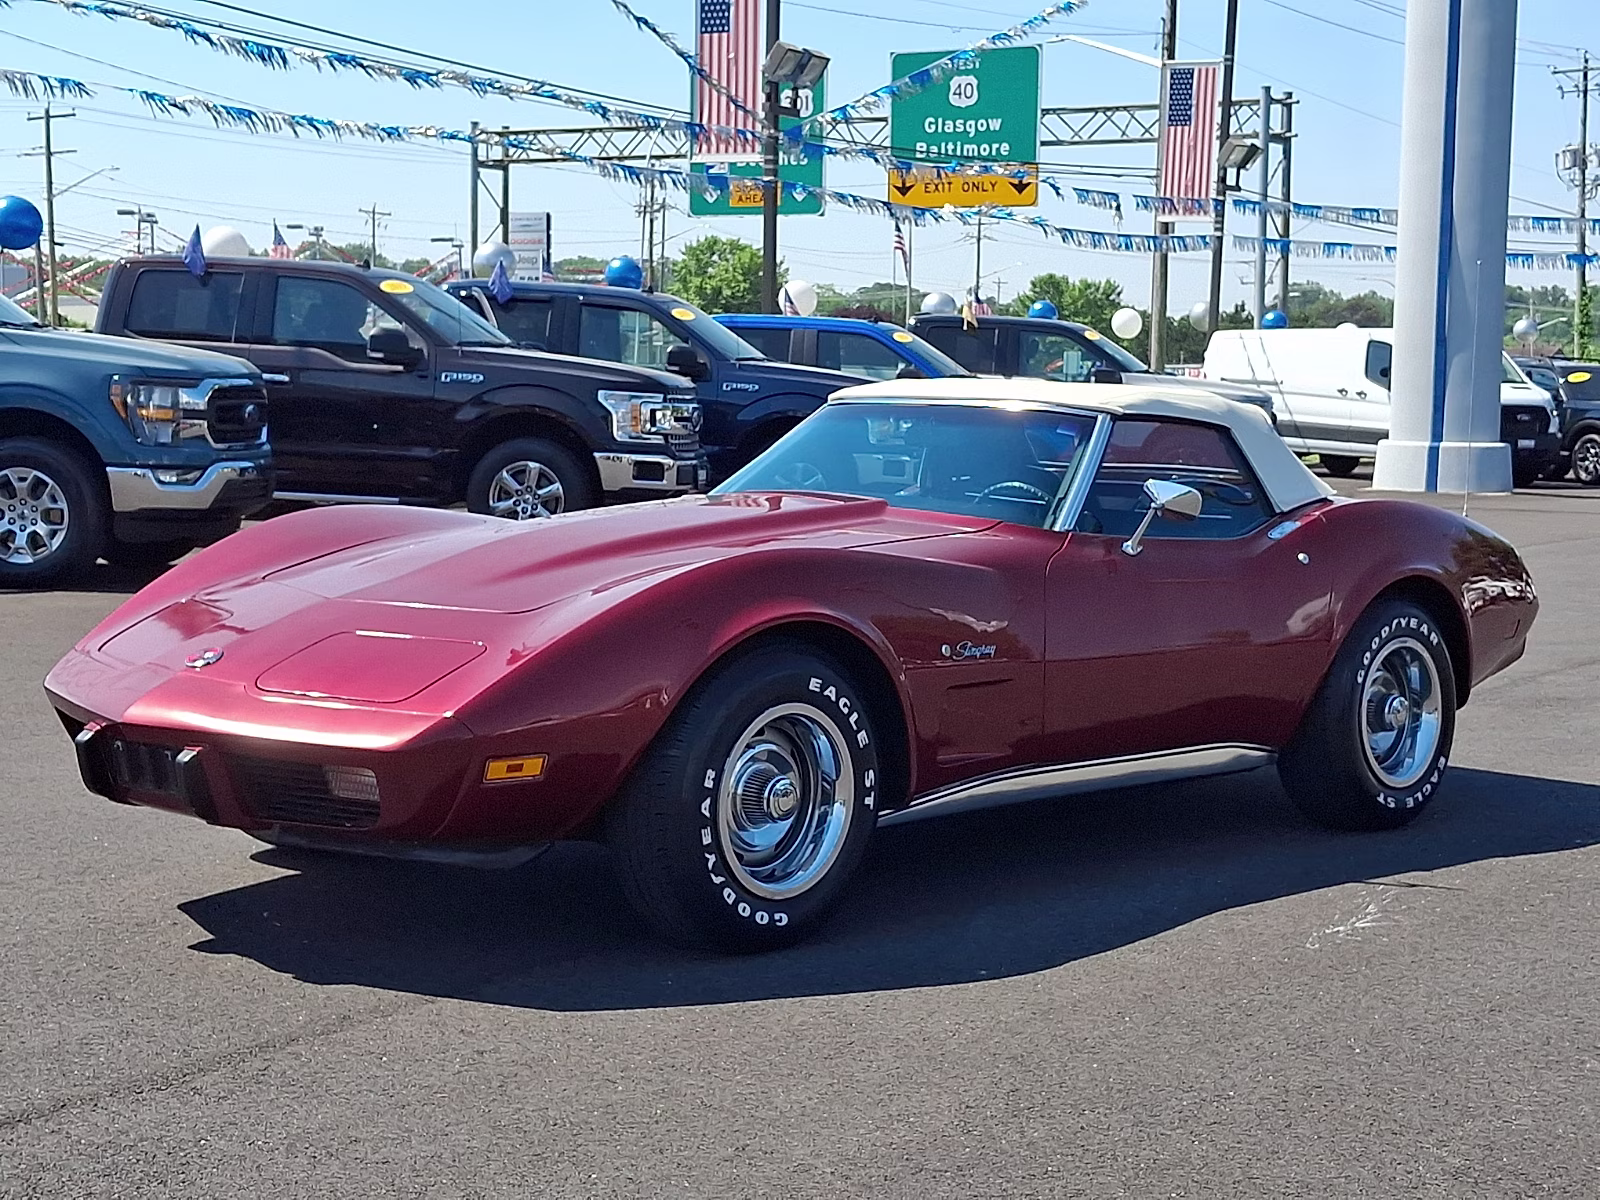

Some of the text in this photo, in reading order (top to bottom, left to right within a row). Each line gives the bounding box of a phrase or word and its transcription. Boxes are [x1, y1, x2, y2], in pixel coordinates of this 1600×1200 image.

[952, 82, 974, 99] 40
[924, 117, 1002, 138] Glasgow
[915, 141, 1010, 158] Baltimore
[924, 181, 998, 194] EXIT ONLY
[737, 193, 765, 203] AHE
[517, 254, 538, 266] Jeep
[952, 640, 997, 660] Stingray
[1357, 616, 1439, 684] GOODYEAR
[808, 677, 875, 810] EAGLE ST
[1377, 756, 1447, 808] EAGLE ST
[700, 768, 789, 927] GOODYEAR
